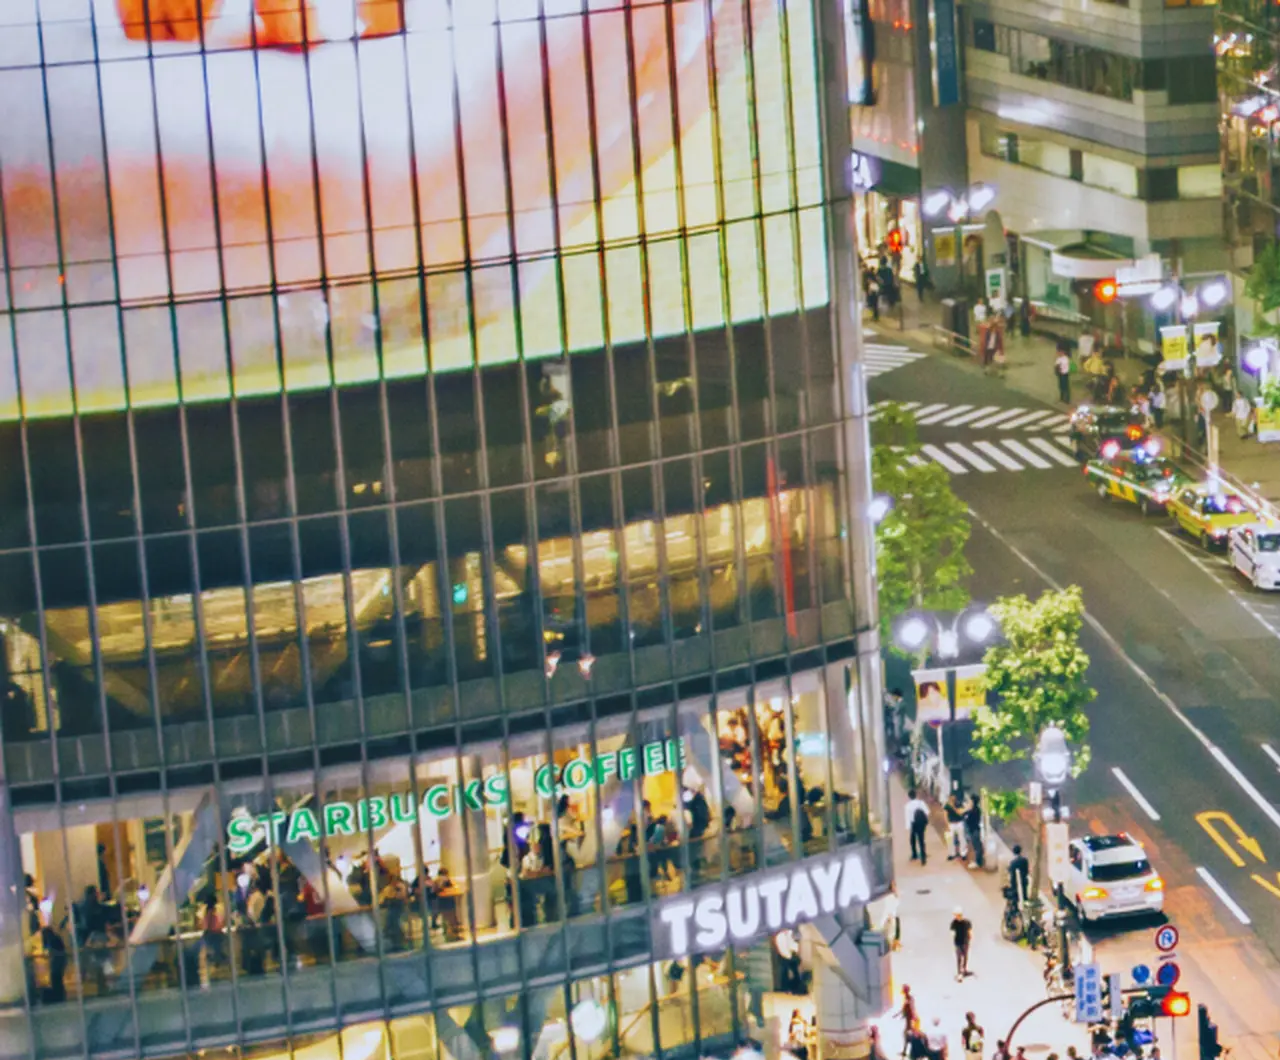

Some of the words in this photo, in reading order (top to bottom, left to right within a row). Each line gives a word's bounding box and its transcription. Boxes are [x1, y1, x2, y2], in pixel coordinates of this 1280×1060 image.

[227, 774, 511, 855] STARBUCKS
[534, 736, 687, 799] COFFEE
[660, 852, 872, 955] TSUTAYA
